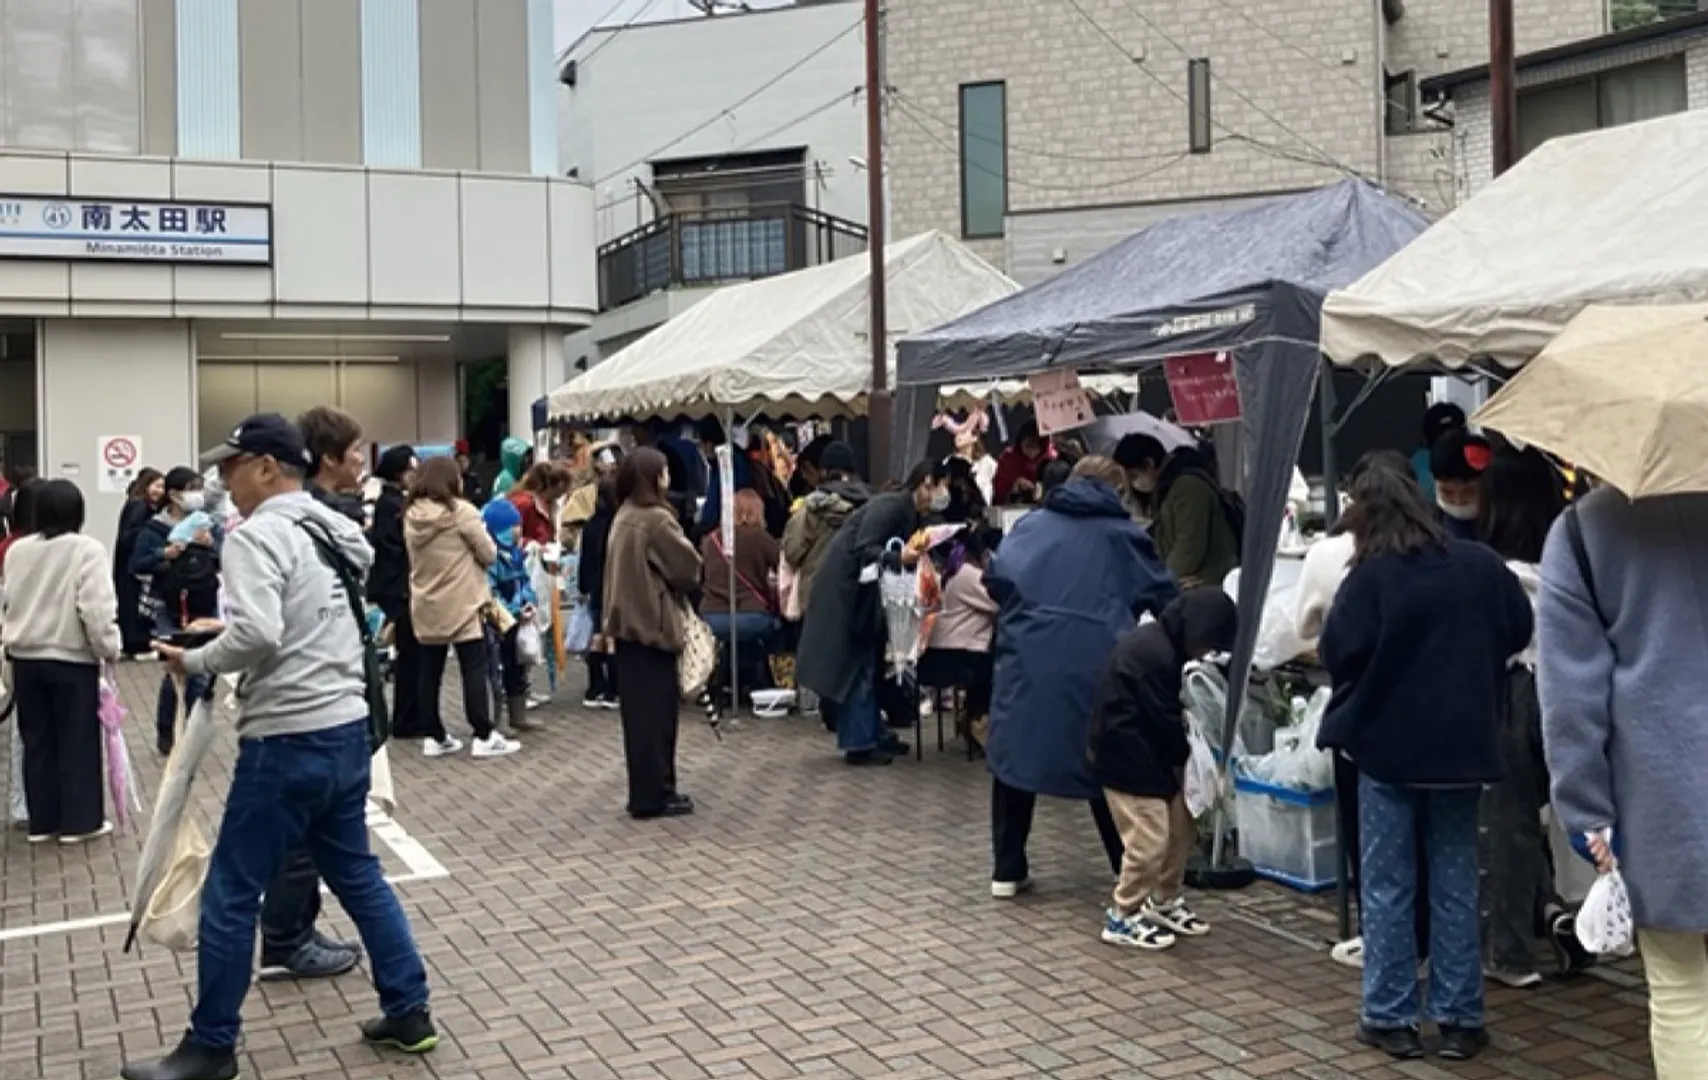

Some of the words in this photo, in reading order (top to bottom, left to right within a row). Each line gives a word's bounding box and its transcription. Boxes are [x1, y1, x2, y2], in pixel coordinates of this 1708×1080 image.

[81, 204, 227, 235] 南太田駅
[170, 244, 223, 257] Station
